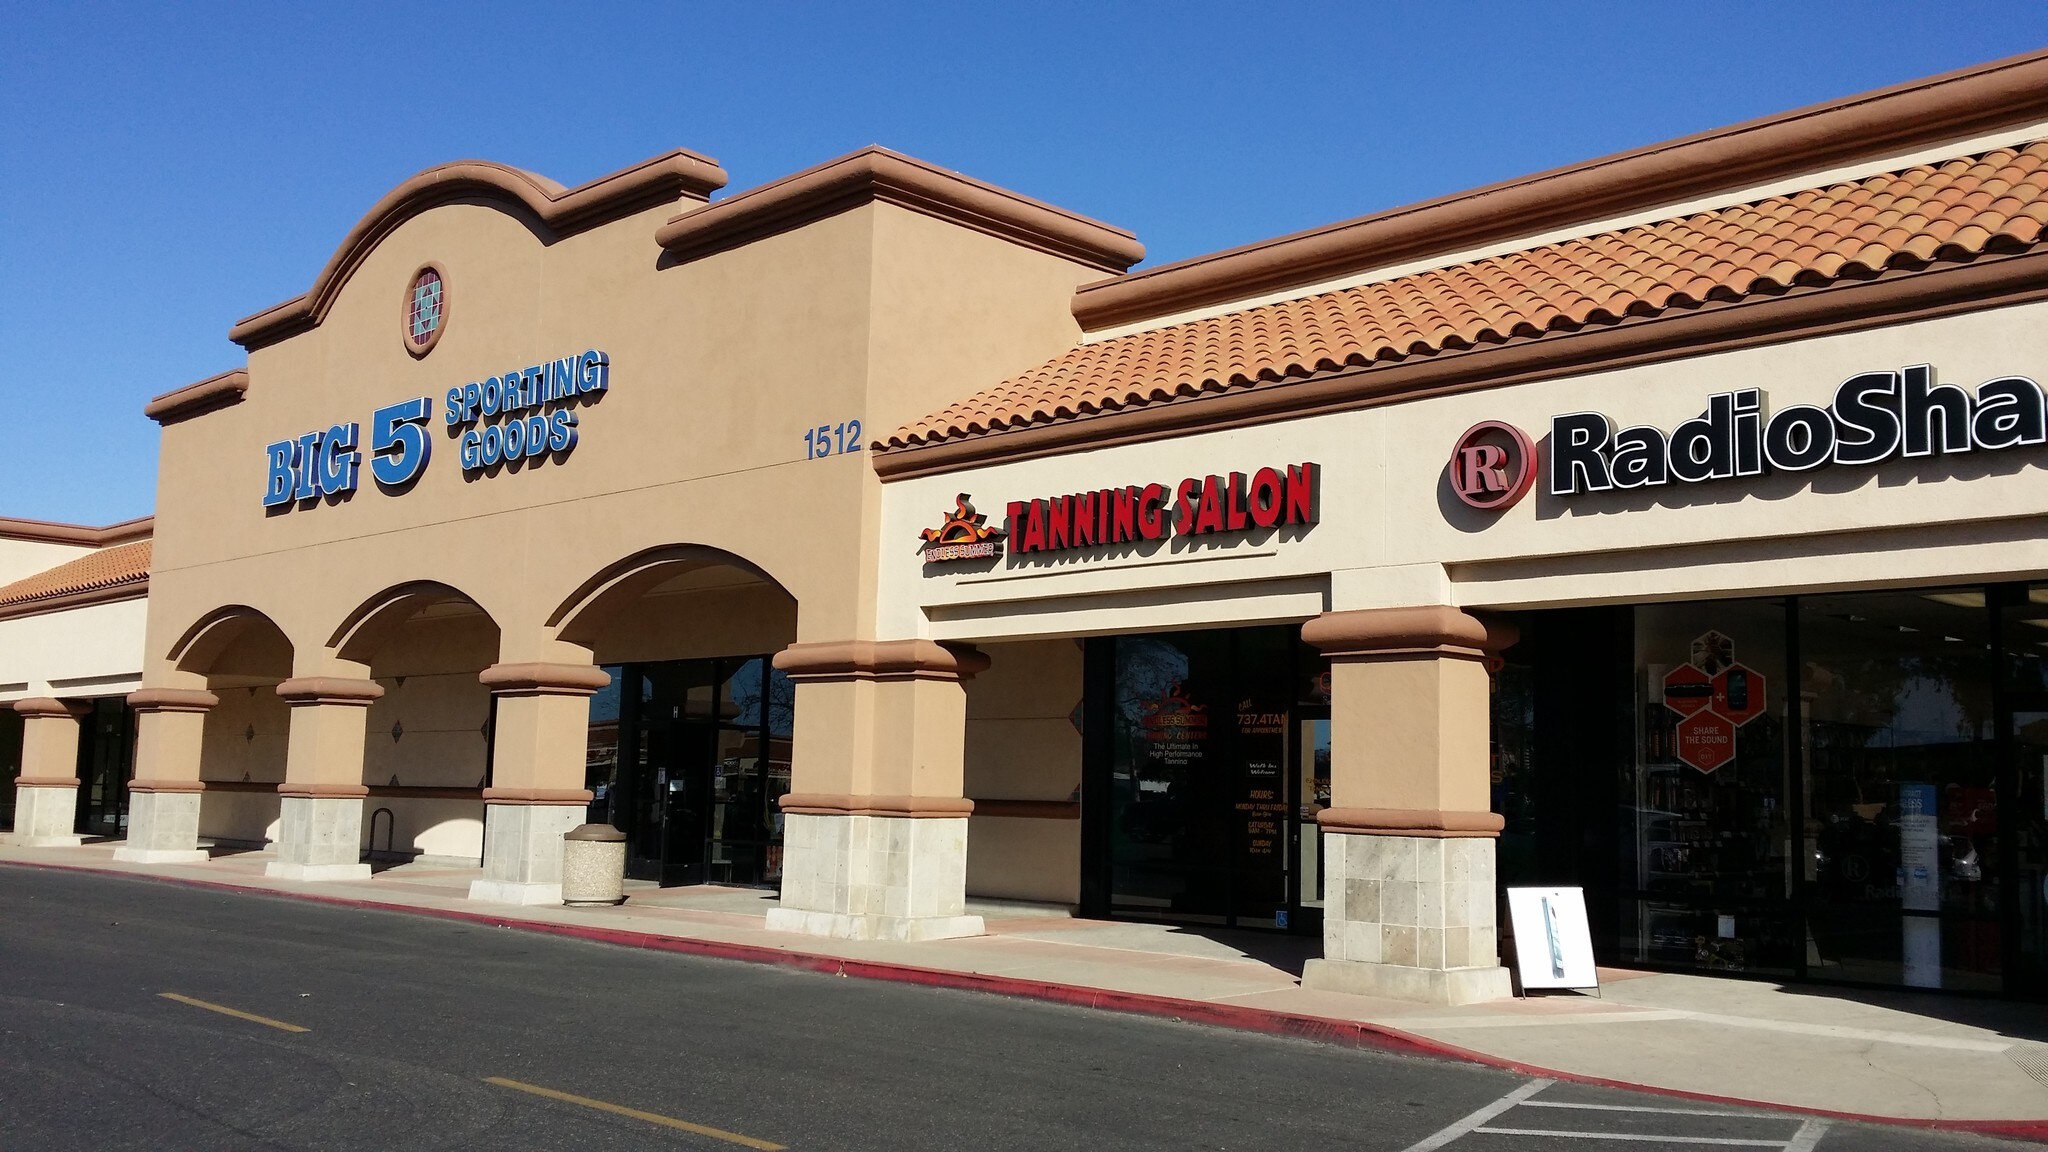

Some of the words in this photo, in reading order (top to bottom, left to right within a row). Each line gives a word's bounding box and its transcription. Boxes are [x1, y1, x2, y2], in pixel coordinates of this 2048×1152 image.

[445, 349, 609, 425] SPORTING
[263, 422, 361, 507] BIG
[370, 396, 432, 485] 5
[460, 409, 578, 470] GOODS
[804, 419, 862, 460] 1512
[1549, 362, 2047, 495] RadioSha
[1006, 483, 1170, 553] TANNING
[1174, 462, 1321, 536] SALON
[925, 545, 959, 562] ENDLESS
[960, 543, 994, 559] SUMMER
[1149, 750, 1163, 759] High
[1164, 750, 1203, 758] Performance
[1685, 736, 1700, 744] THE
[1701, 736, 1728, 744] SOUND
[1694, 726, 1719, 735] SHARE
